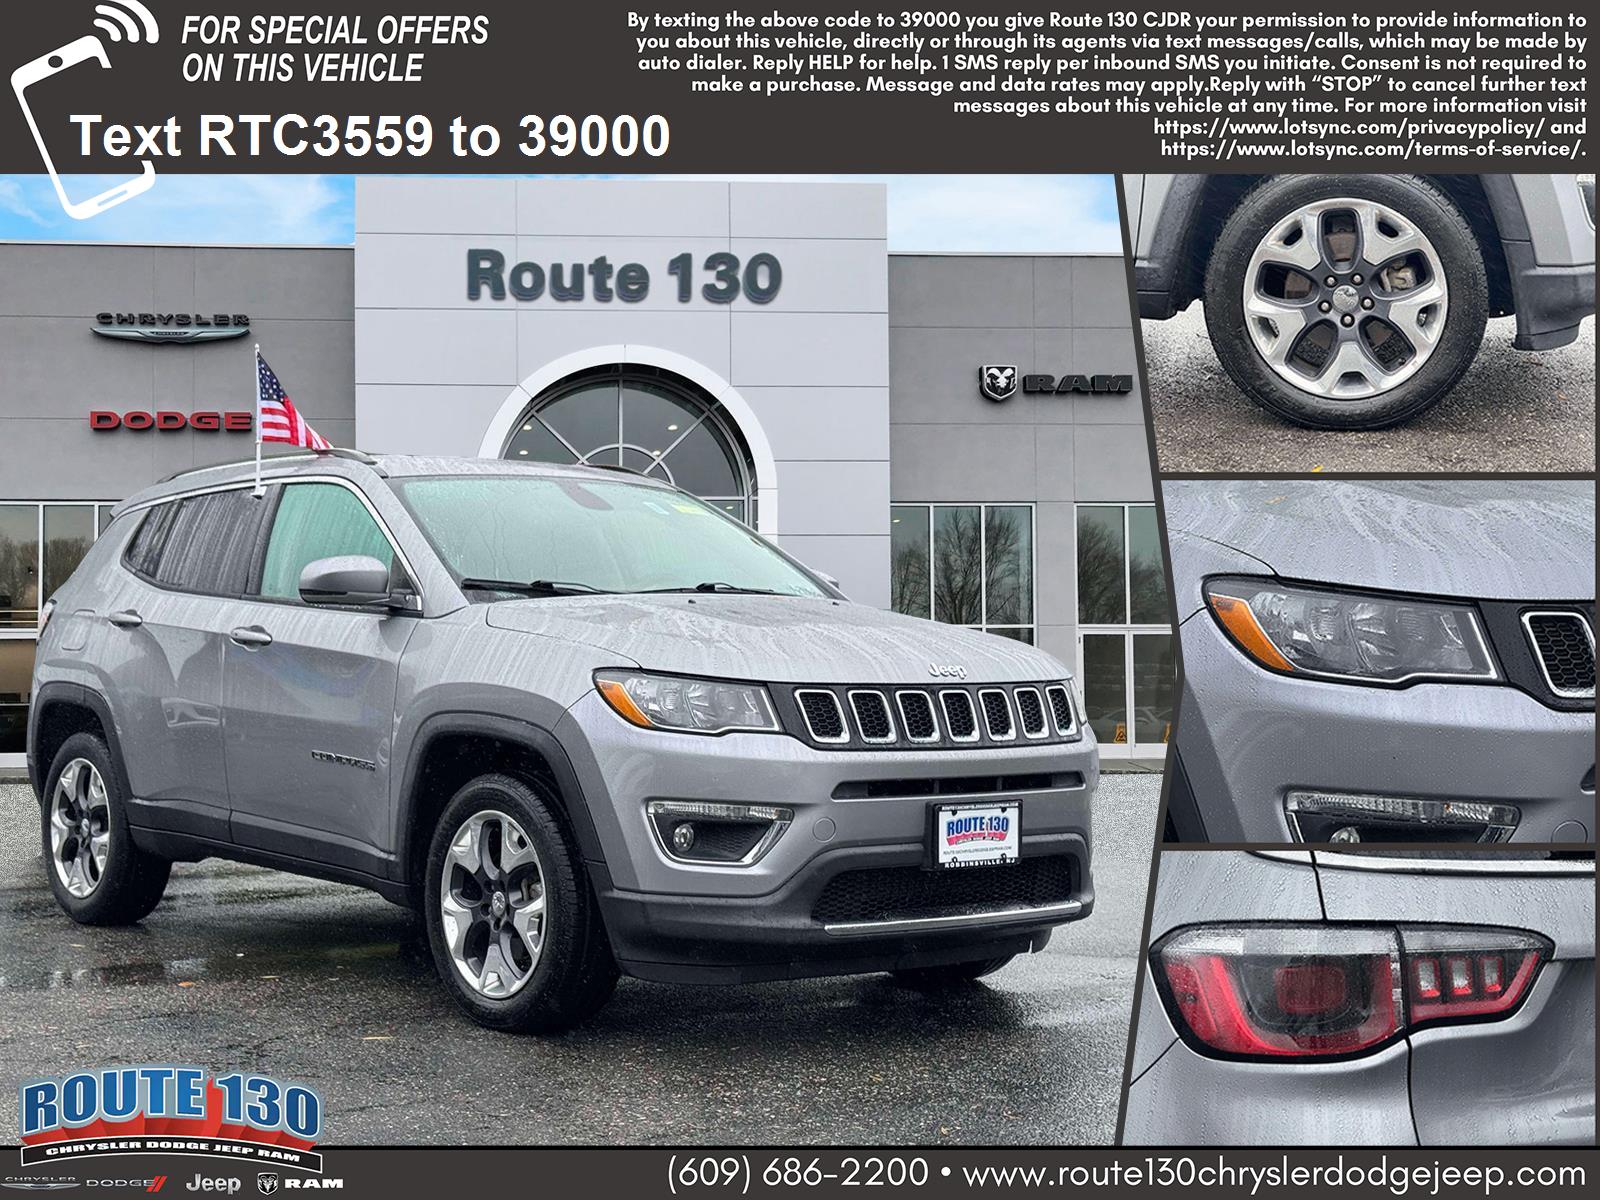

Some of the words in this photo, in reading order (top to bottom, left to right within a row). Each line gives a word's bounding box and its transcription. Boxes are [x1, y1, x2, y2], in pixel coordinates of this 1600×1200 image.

[466, 248, 650, 303] Route
[668, 251, 782, 304] 130
[96, 312, 250, 326] CHRYSLER
[1023, 374, 1133, 395] RAM
[90, 410, 252, 431] DODGE
[928, 662, 968, 680] Jeep
[946, 816, 985, 837] ROUTE
[987, 816, 1009, 832] 130
